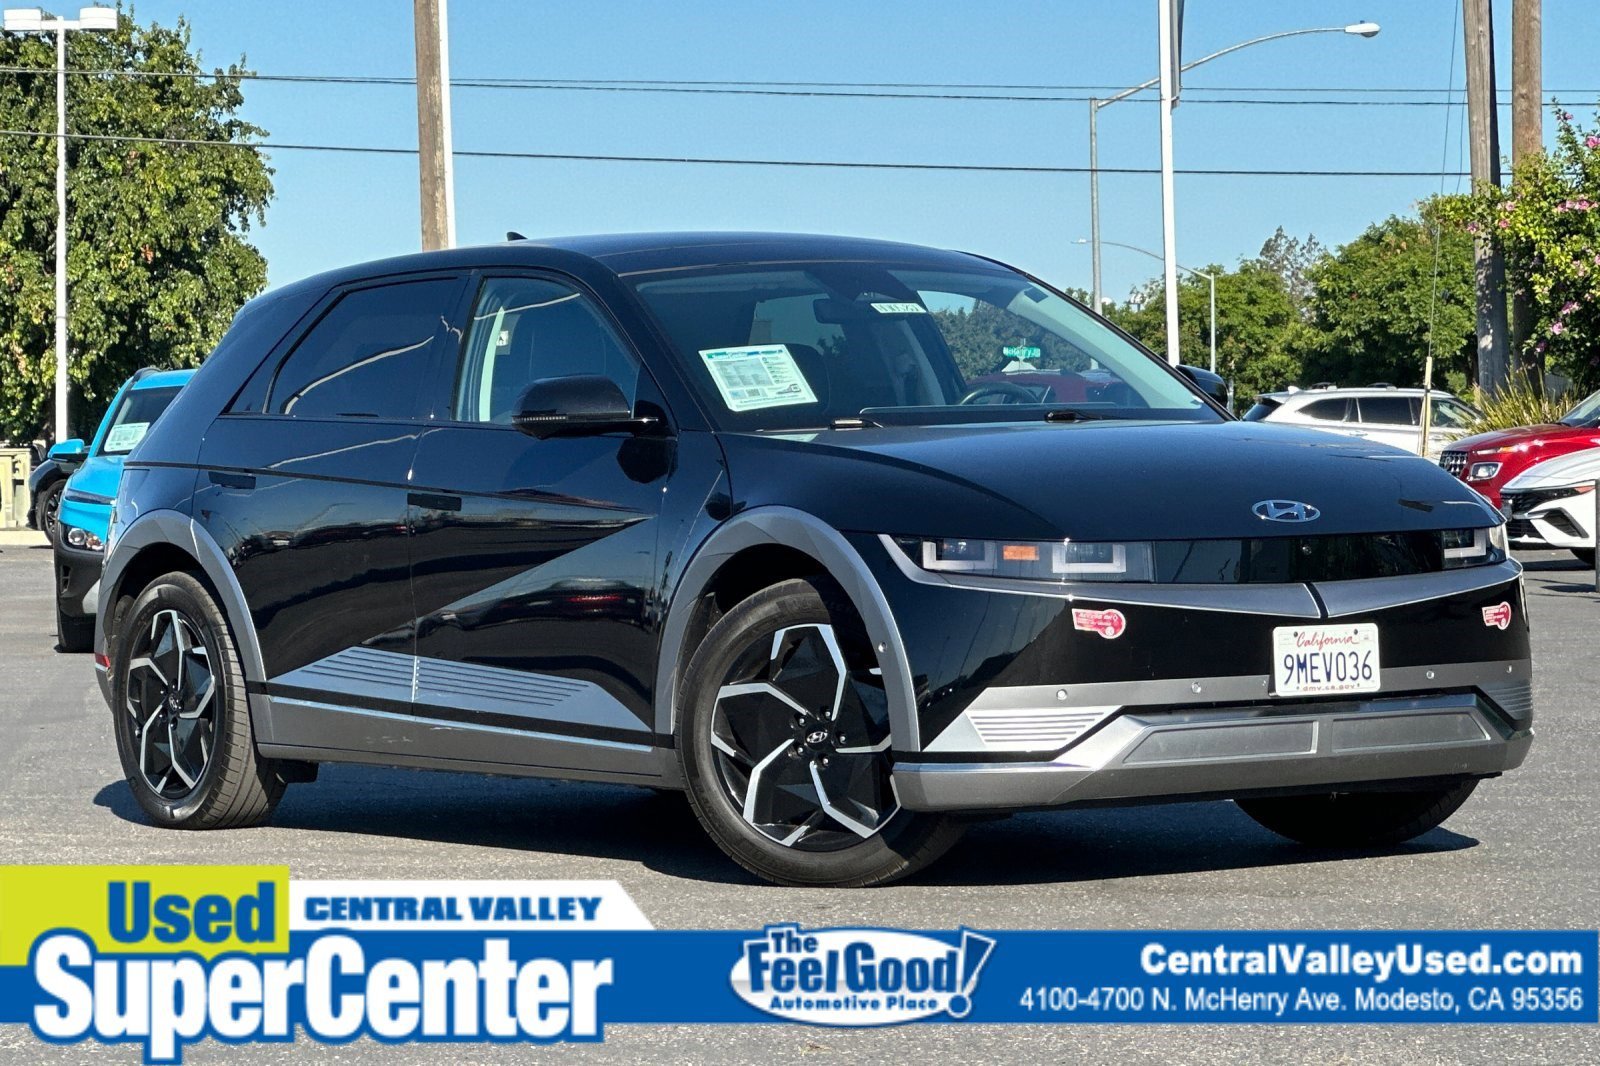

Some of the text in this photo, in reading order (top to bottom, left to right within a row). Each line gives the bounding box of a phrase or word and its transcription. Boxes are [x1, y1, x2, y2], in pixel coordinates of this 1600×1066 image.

[1297, 631, 1360, 651] California
[1284, 649, 1372, 686] 9MEV036
[1303, 684, 1355, 692] dmv.ca.gov
